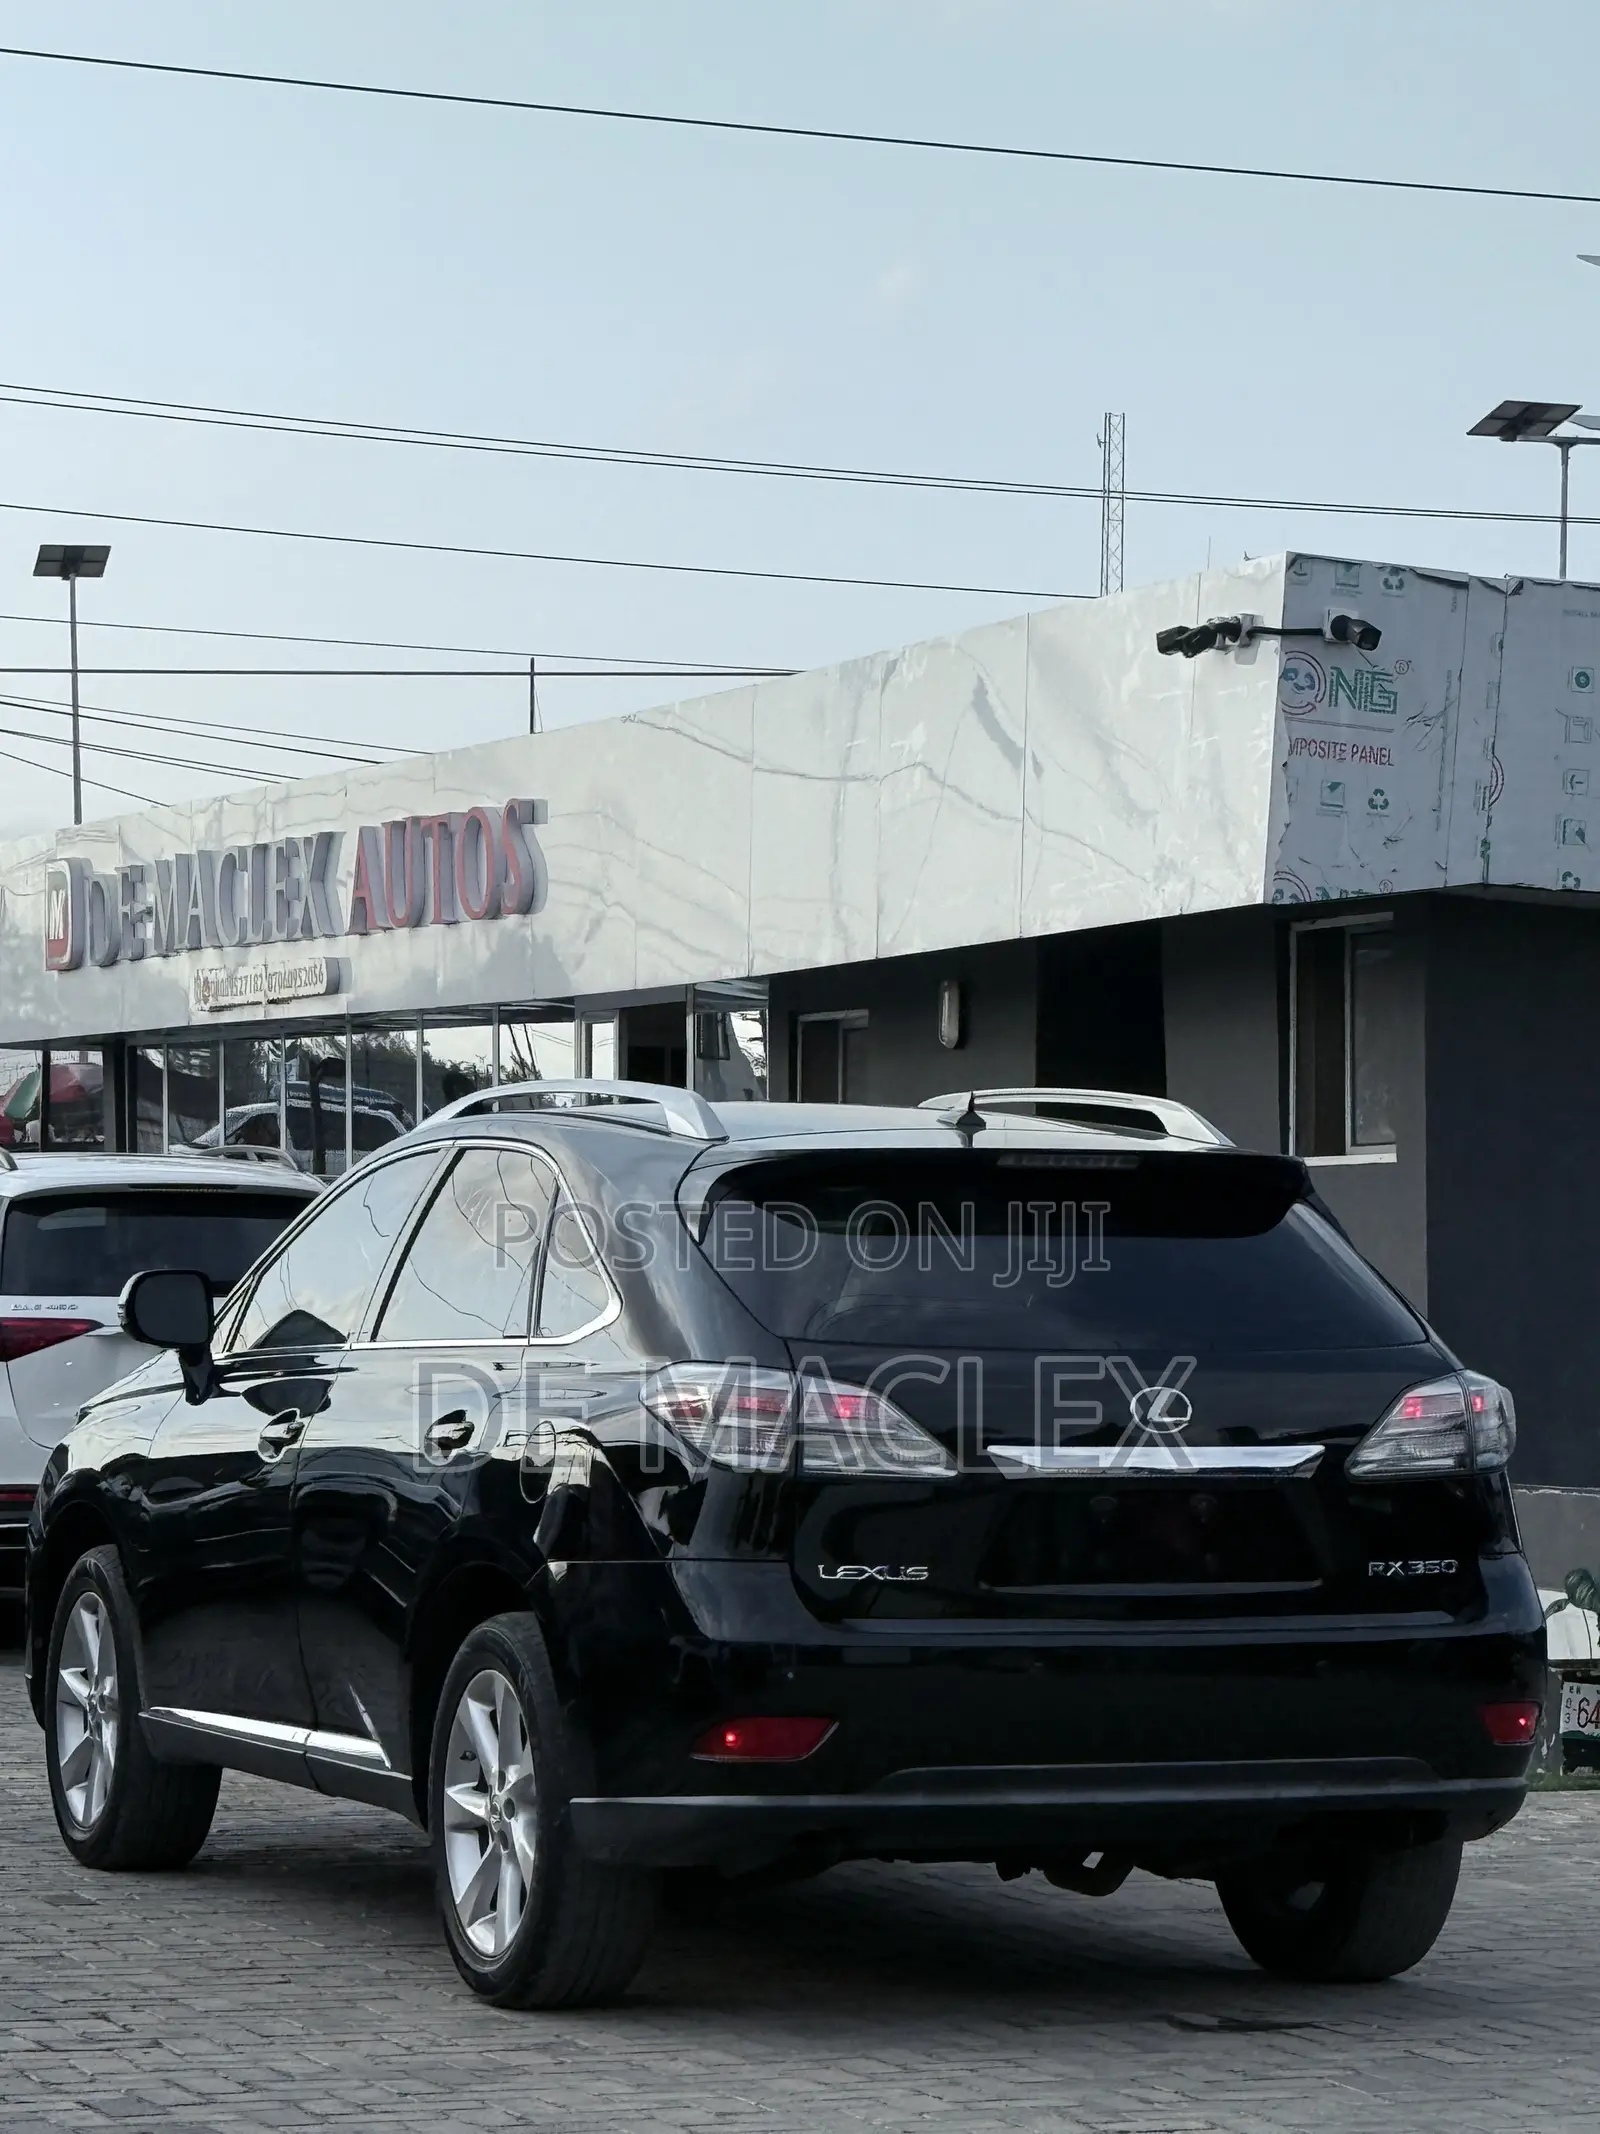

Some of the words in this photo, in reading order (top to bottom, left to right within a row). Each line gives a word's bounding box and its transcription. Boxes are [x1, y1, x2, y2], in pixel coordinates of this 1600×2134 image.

[1351, 743, 1395, 767] PANEL
[348, 798, 548, 936] AUTOS
[818, 1564, 929, 1581] LEXUS
